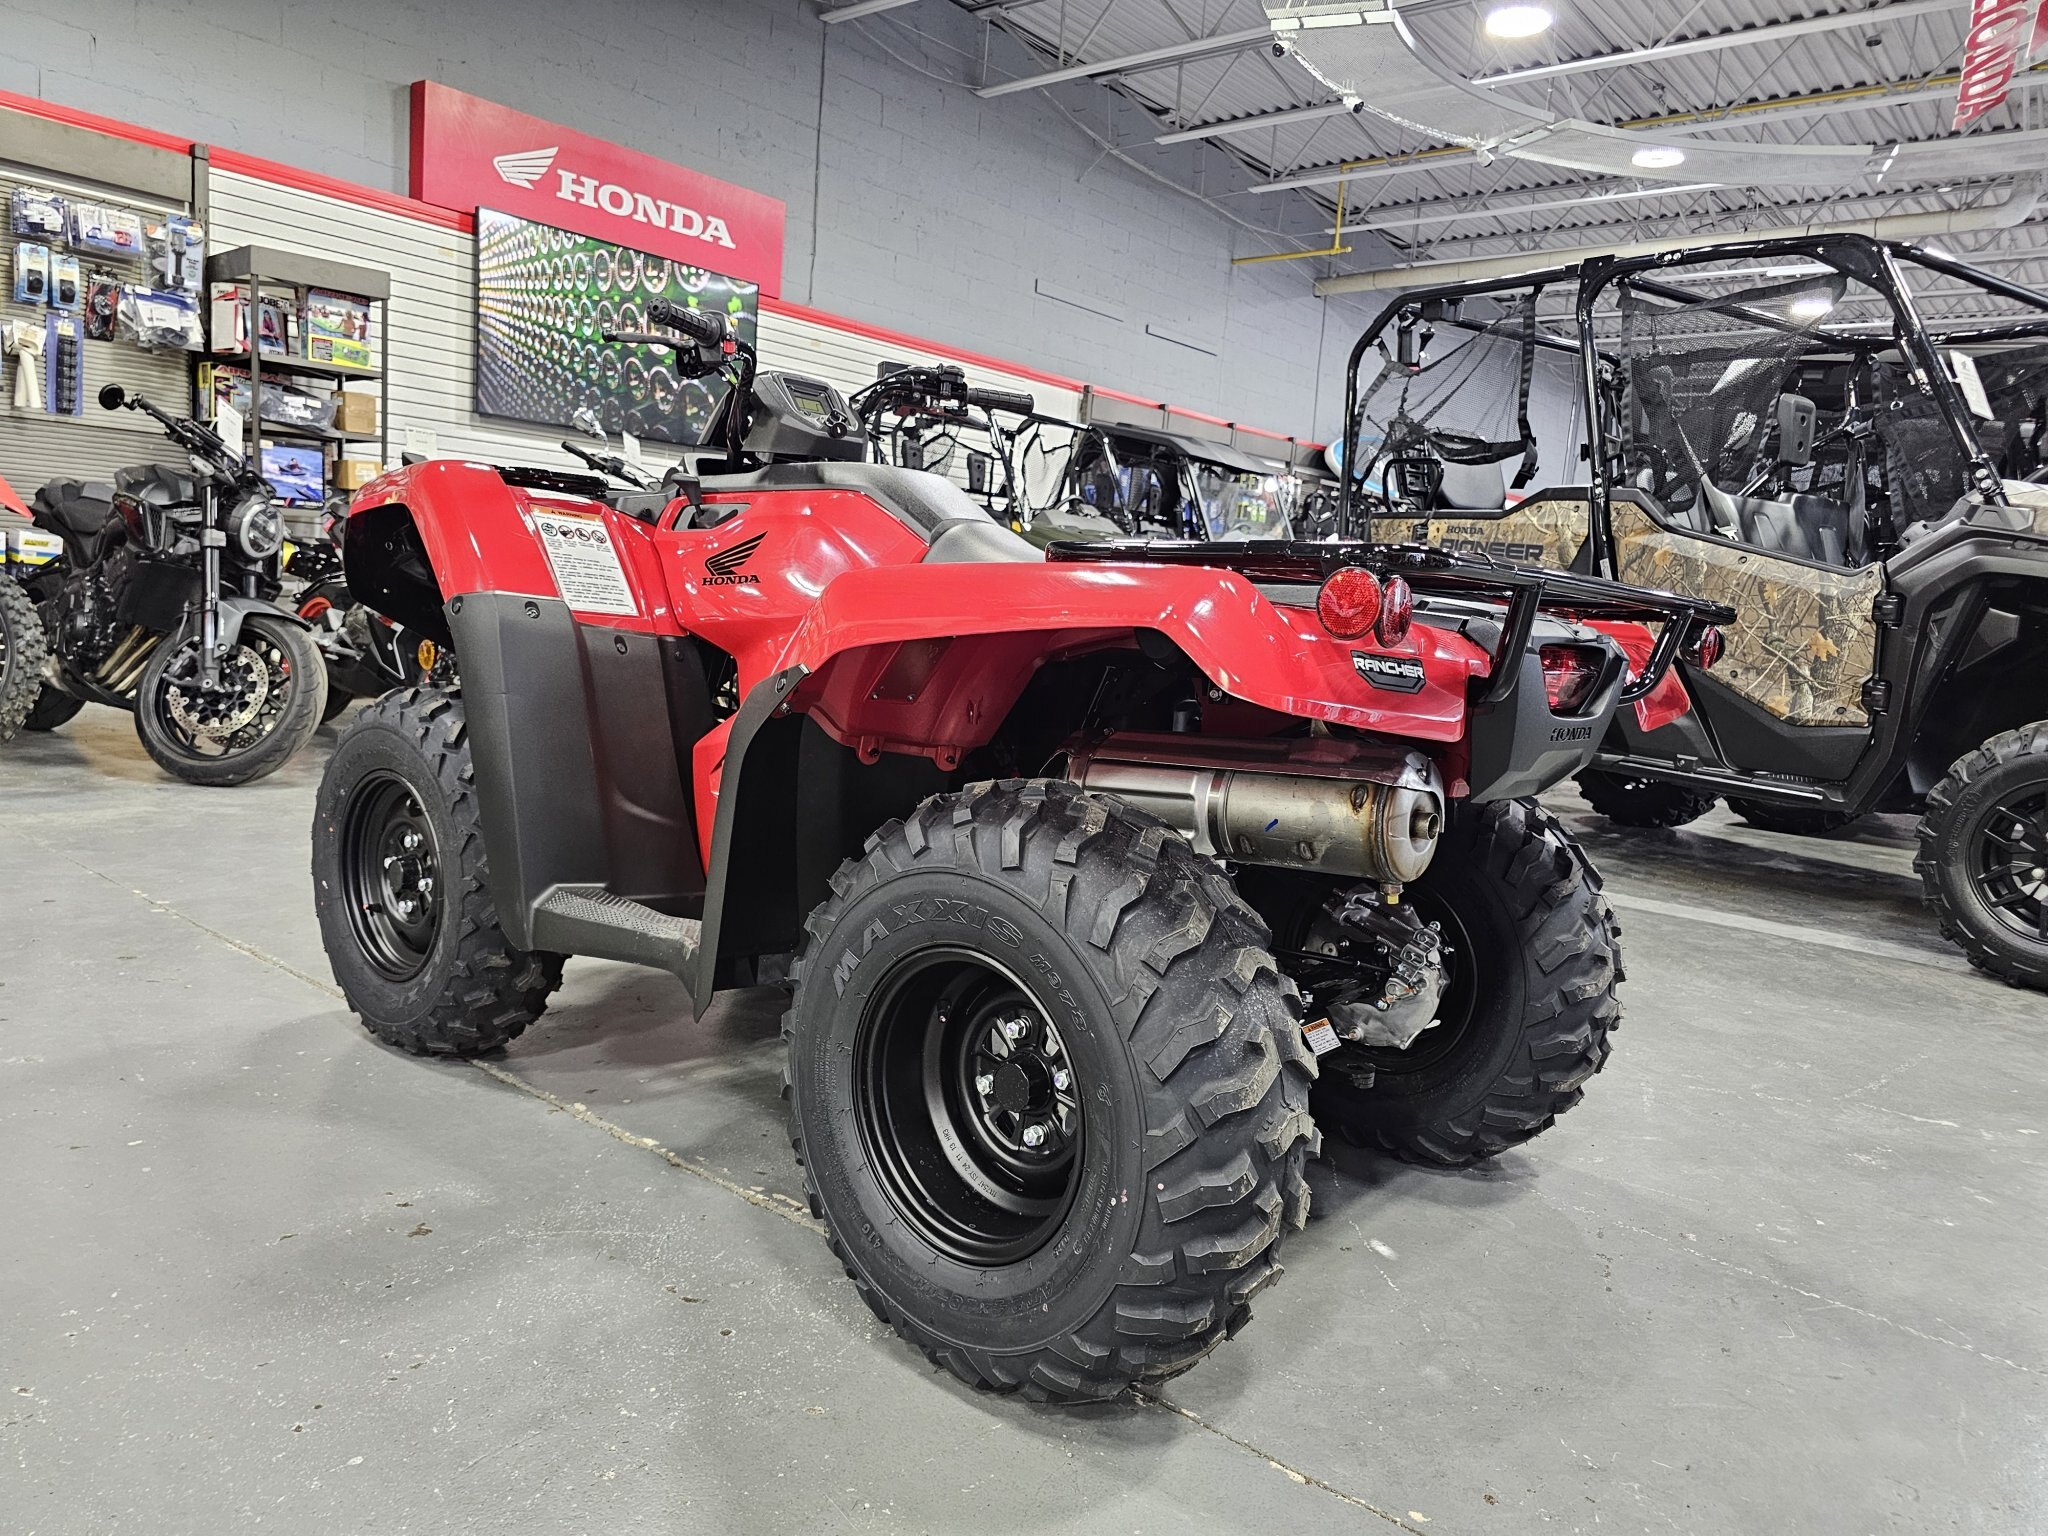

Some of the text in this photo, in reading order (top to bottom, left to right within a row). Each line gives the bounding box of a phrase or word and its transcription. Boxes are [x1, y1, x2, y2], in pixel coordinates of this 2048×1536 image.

[556, 168, 737, 250] HONDA
[1446, 525, 1485, 535] HONDA
[1440, 538, 1544, 561] PIONEER
[702, 574, 761, 586] HONDA
[1352, 657, 1425, 679] RANCHER
[1549, 726, 1593, 742] HONDA
[833, 899, 1023, 1000] MAXXIS
[961, 1162, 971, 1172] 24
